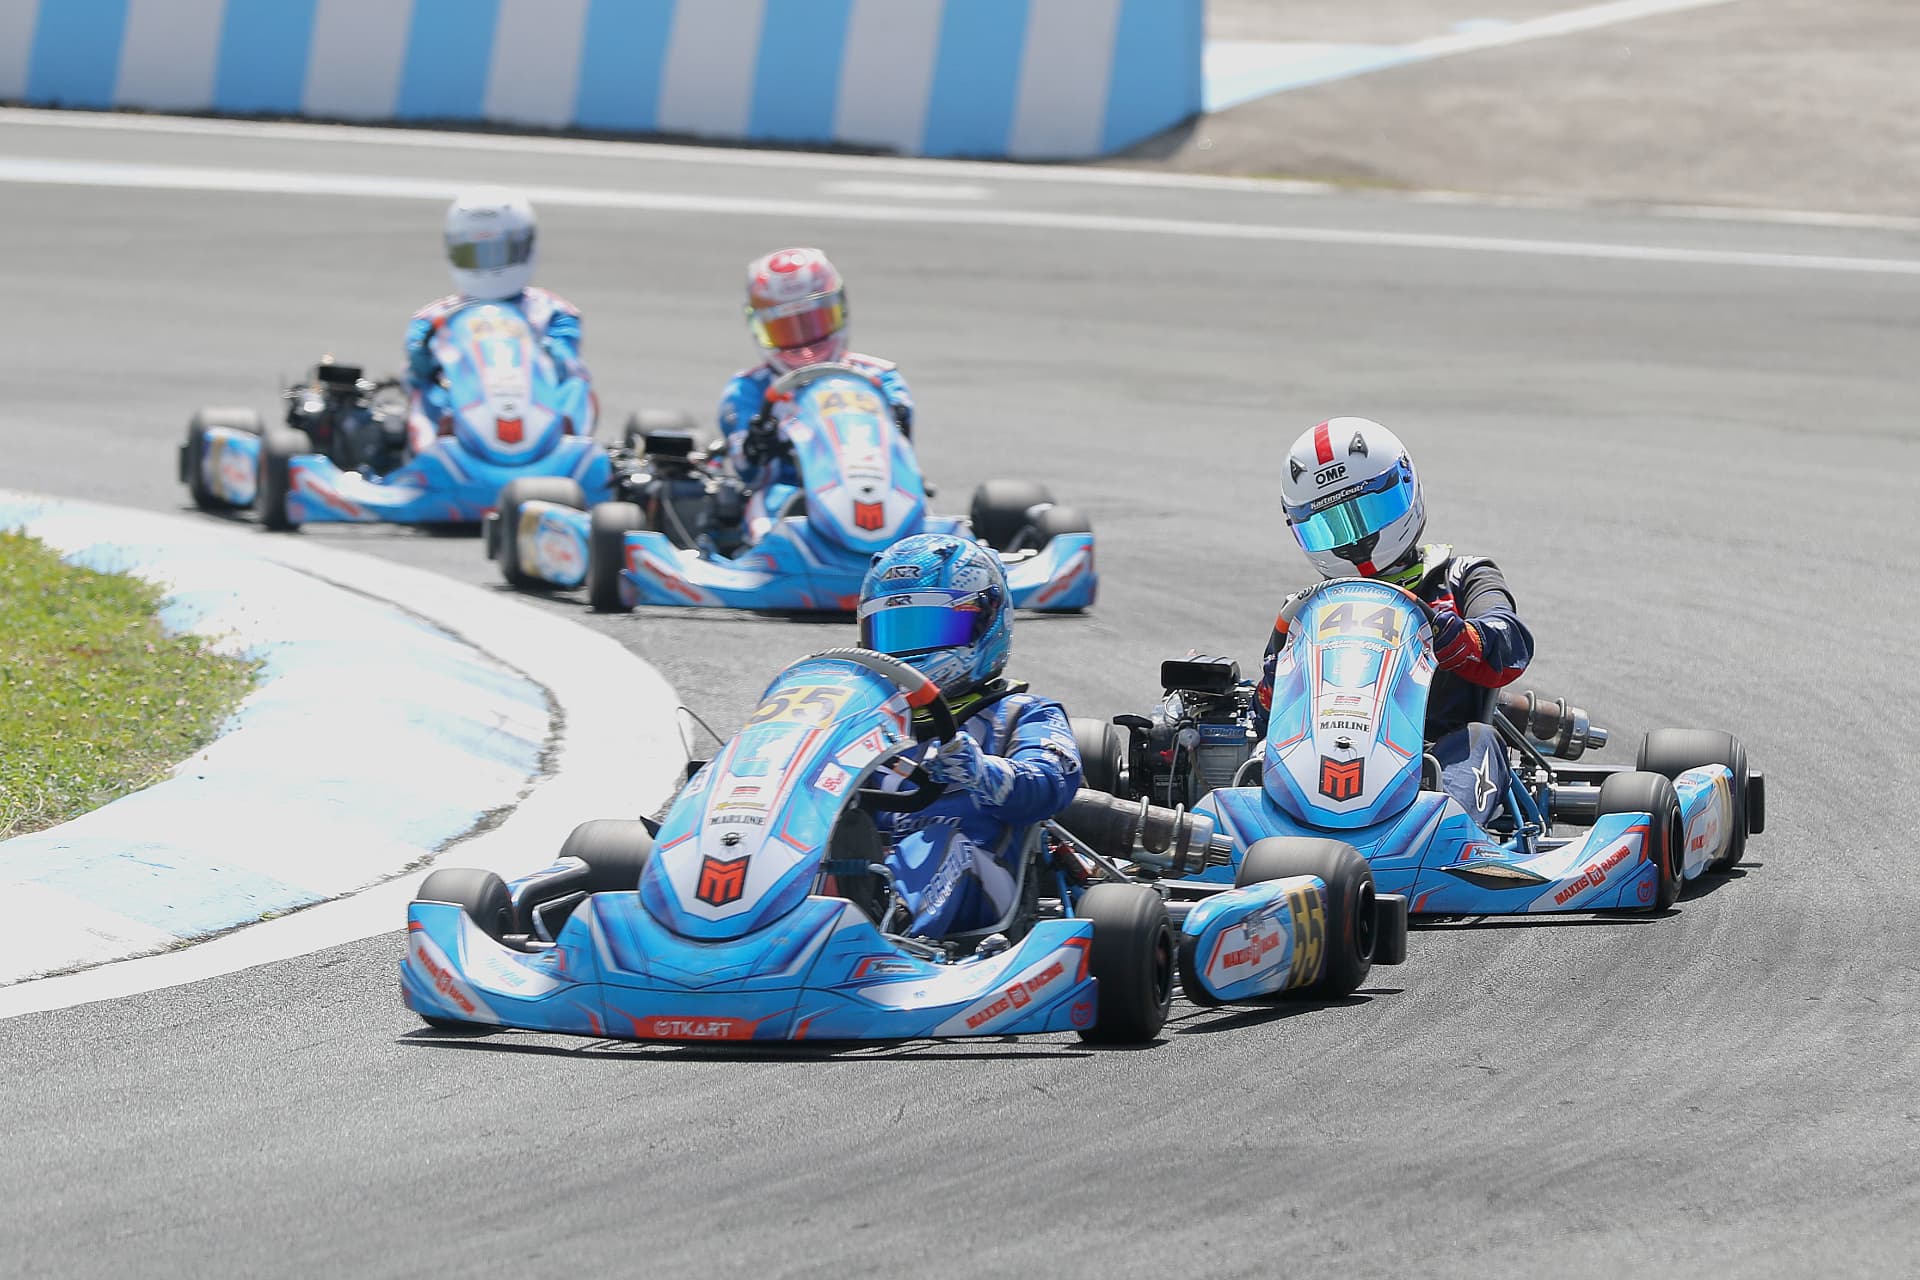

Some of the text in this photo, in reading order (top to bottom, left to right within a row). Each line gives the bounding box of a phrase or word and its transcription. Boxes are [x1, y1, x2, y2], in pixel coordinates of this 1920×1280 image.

[1315, 465, 1346, 485] OMP
[1319, 602, 1399, 642] 44
[750, 687, 846, 724] 55
[1320, 720, 1370, 732] MARLINE
[1554, 875, 1590, 905] MAXXIS
[1600, 844, 1631, 872] RACING
